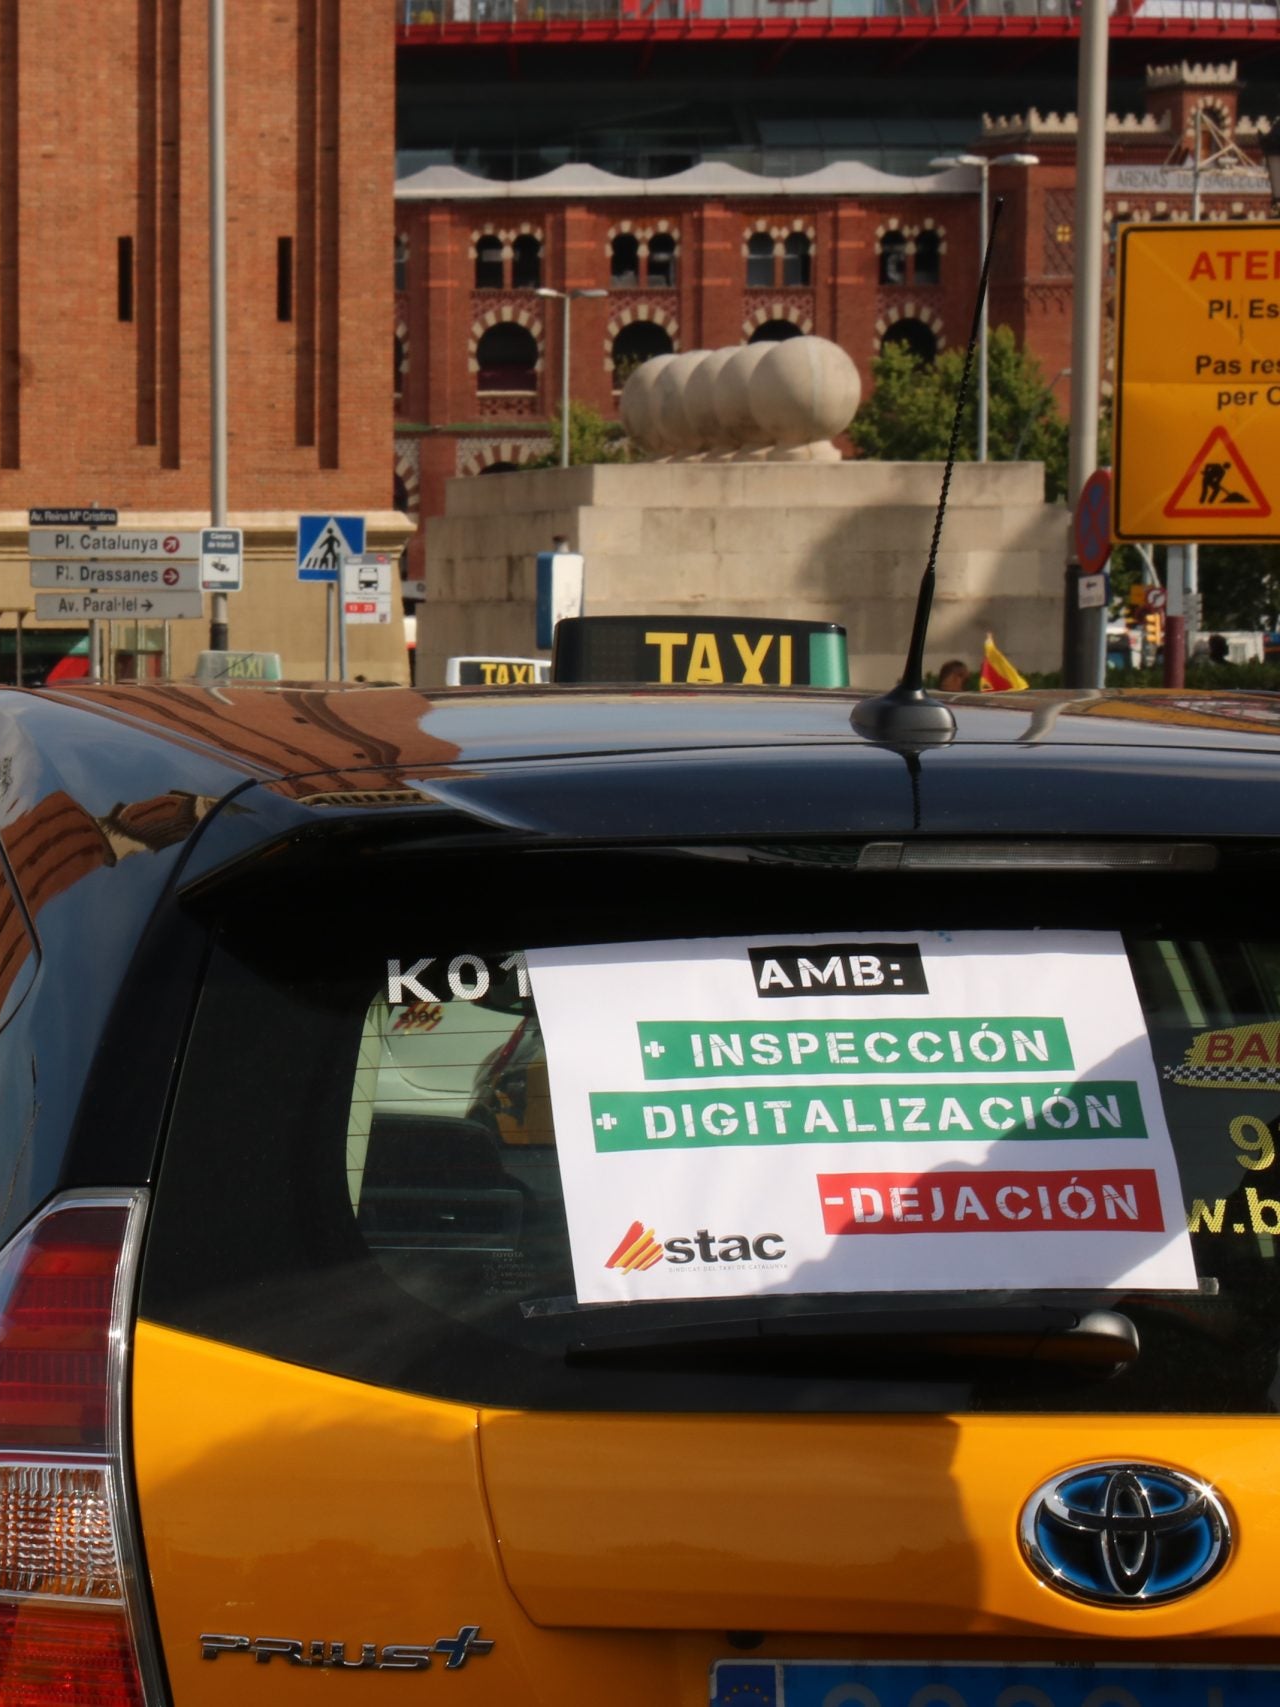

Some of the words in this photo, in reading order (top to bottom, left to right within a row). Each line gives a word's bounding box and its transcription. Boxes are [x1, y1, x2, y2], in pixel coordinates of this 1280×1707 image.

[1188, 251, 1280, 281] ATE
[1208, 299, 1239, 319] Pl.
[1195, 355, 1242, 375] Pas
[1217, 391, 1258, 411] per
[83, 511, 116, 522] Cristina
[55, 535, 74, 549] Pl.
[81, 535, 159, 553] Catalunya
[80, 566, 158, 582] Drassanes
[58, 598, 78, 612] Av.
[226, 656, 264, 677] TAXI
[645, 632, 792, 686] TAXI
[480, 663, 534, 685] TAXI
[758, 955, 904, 990] AMB:
[690, 1023, 1049, 1067] INSPECCIÓN
[1204, 1031, 1280, 1064] BA
[643, 1087, 1122, 1139] DIGITALIZACIÓN
[664, 1229, 786, 1264] stac
